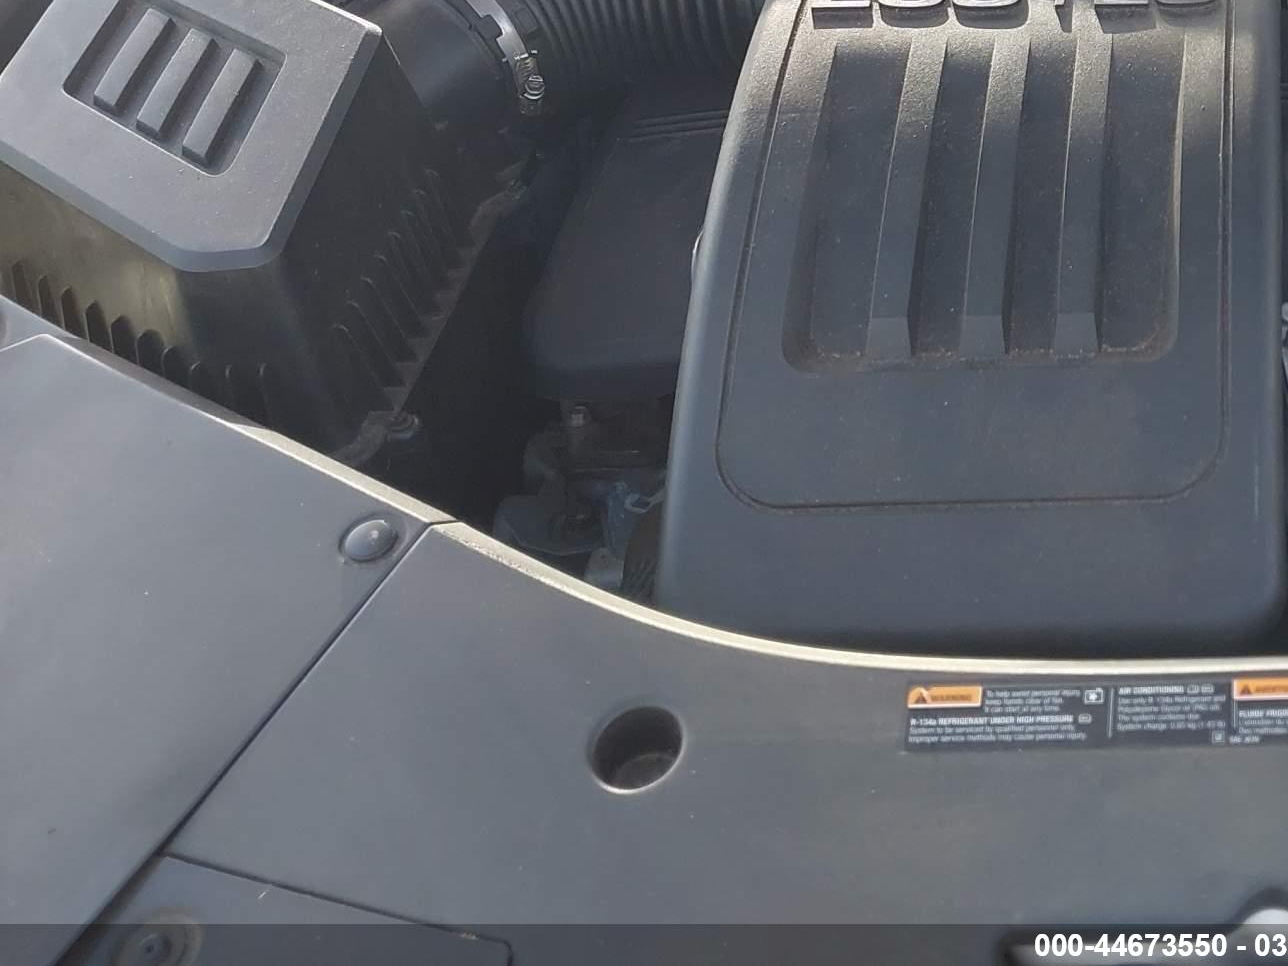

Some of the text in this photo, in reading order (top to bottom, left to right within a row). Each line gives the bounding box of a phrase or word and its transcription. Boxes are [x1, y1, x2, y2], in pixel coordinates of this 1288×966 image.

[1133, 686, 1184, 694] CONDITIONING
[910, 718, 937, 726] R-134a
[938, 717, 988, 725] REFRIGERANT
[990, 716, 1015, 724] UNDER
